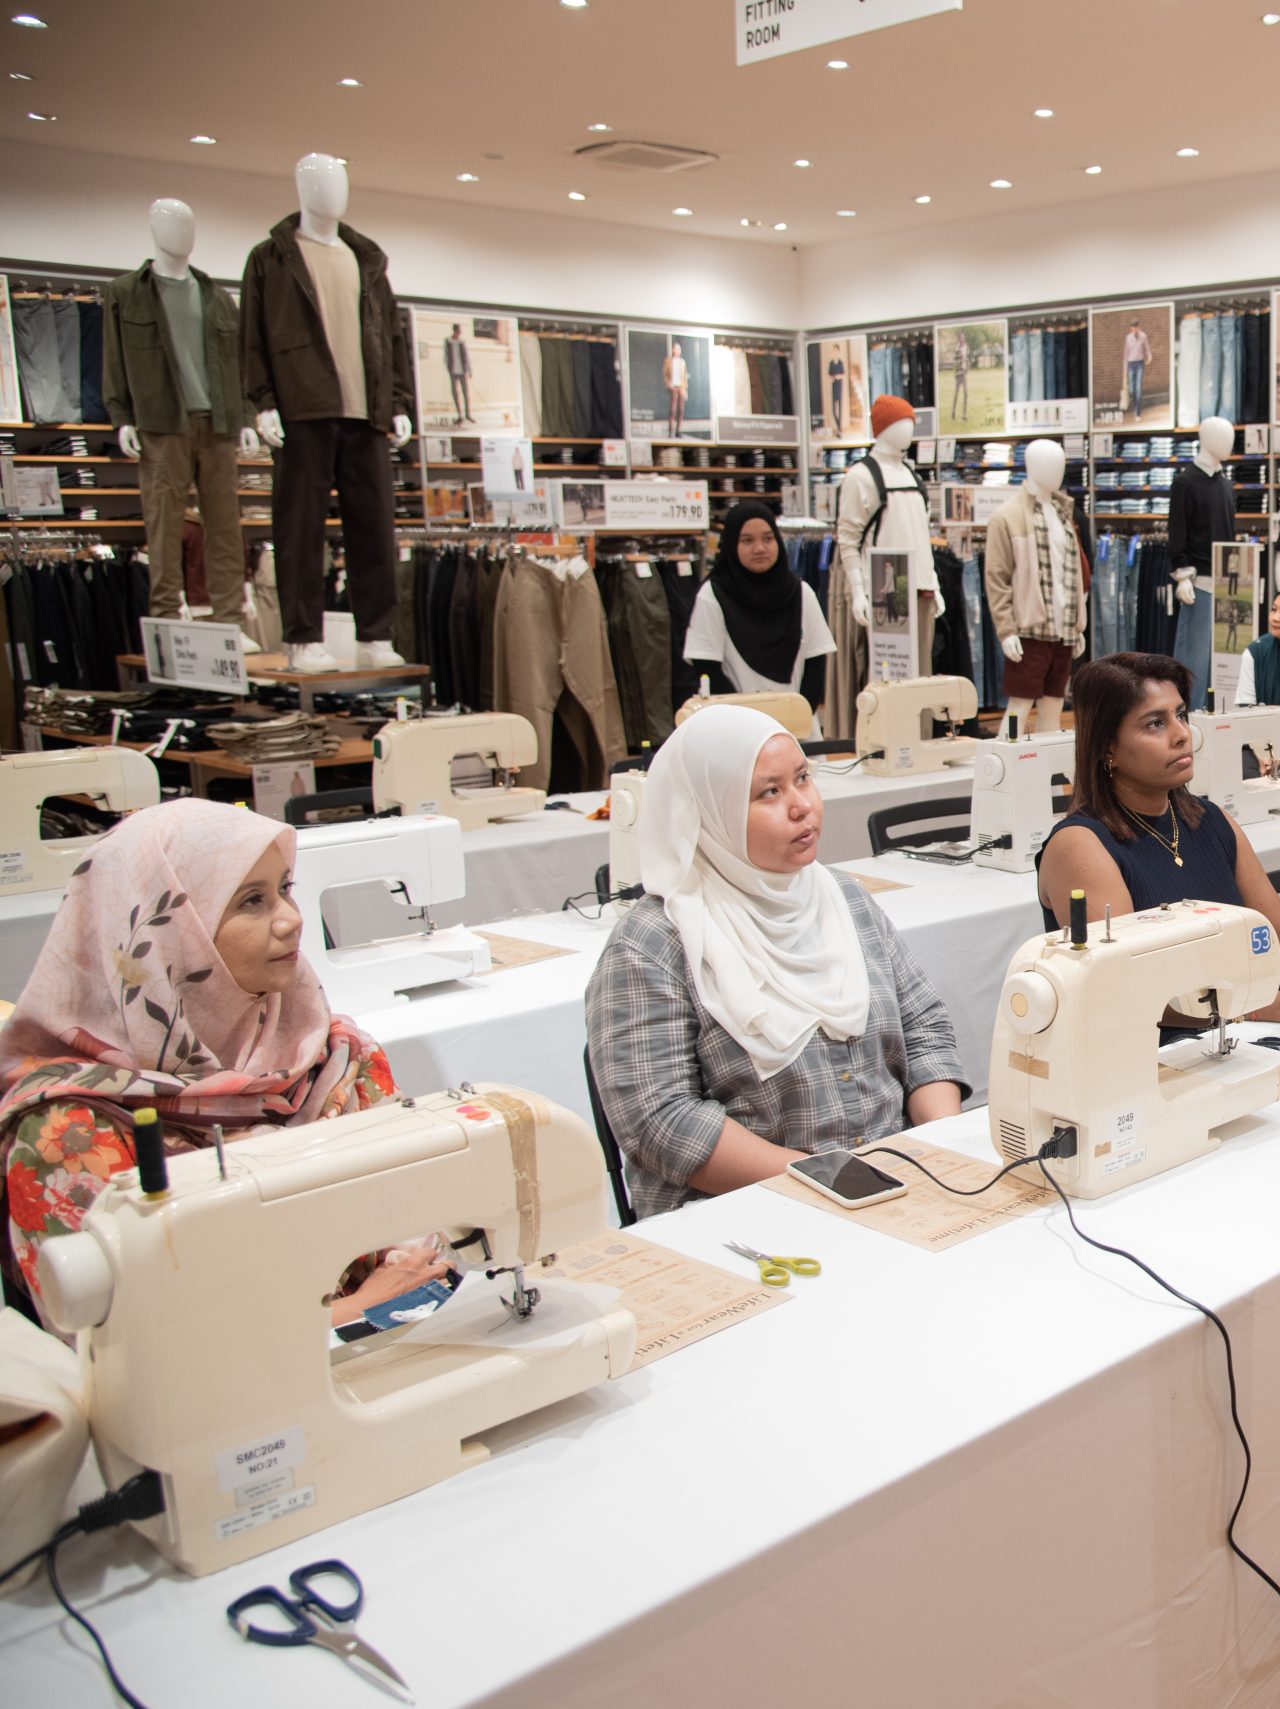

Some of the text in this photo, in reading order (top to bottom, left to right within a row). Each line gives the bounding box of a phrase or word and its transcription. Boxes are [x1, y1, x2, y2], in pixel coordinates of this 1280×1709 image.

[746, 0, 795, 24] FITTING
[746, 22, 780, 49] ROOM
[670, 506, 702, 518] 179.90
[1252, 928, 1270, 951] 53
[1117, 1112, 1134, 1126] 2049
[1004, 1189, 1051, 1212] ifeWear
[928, 1218, 986, 1243] Lifetime
[704, 1292, 772, 1325] LifeWear
[634, 1333, 681, 1357] Lifeti
[236, 1438, 286, 1465] SMC2049
[248, 1457, 278, 1474] NO:21
